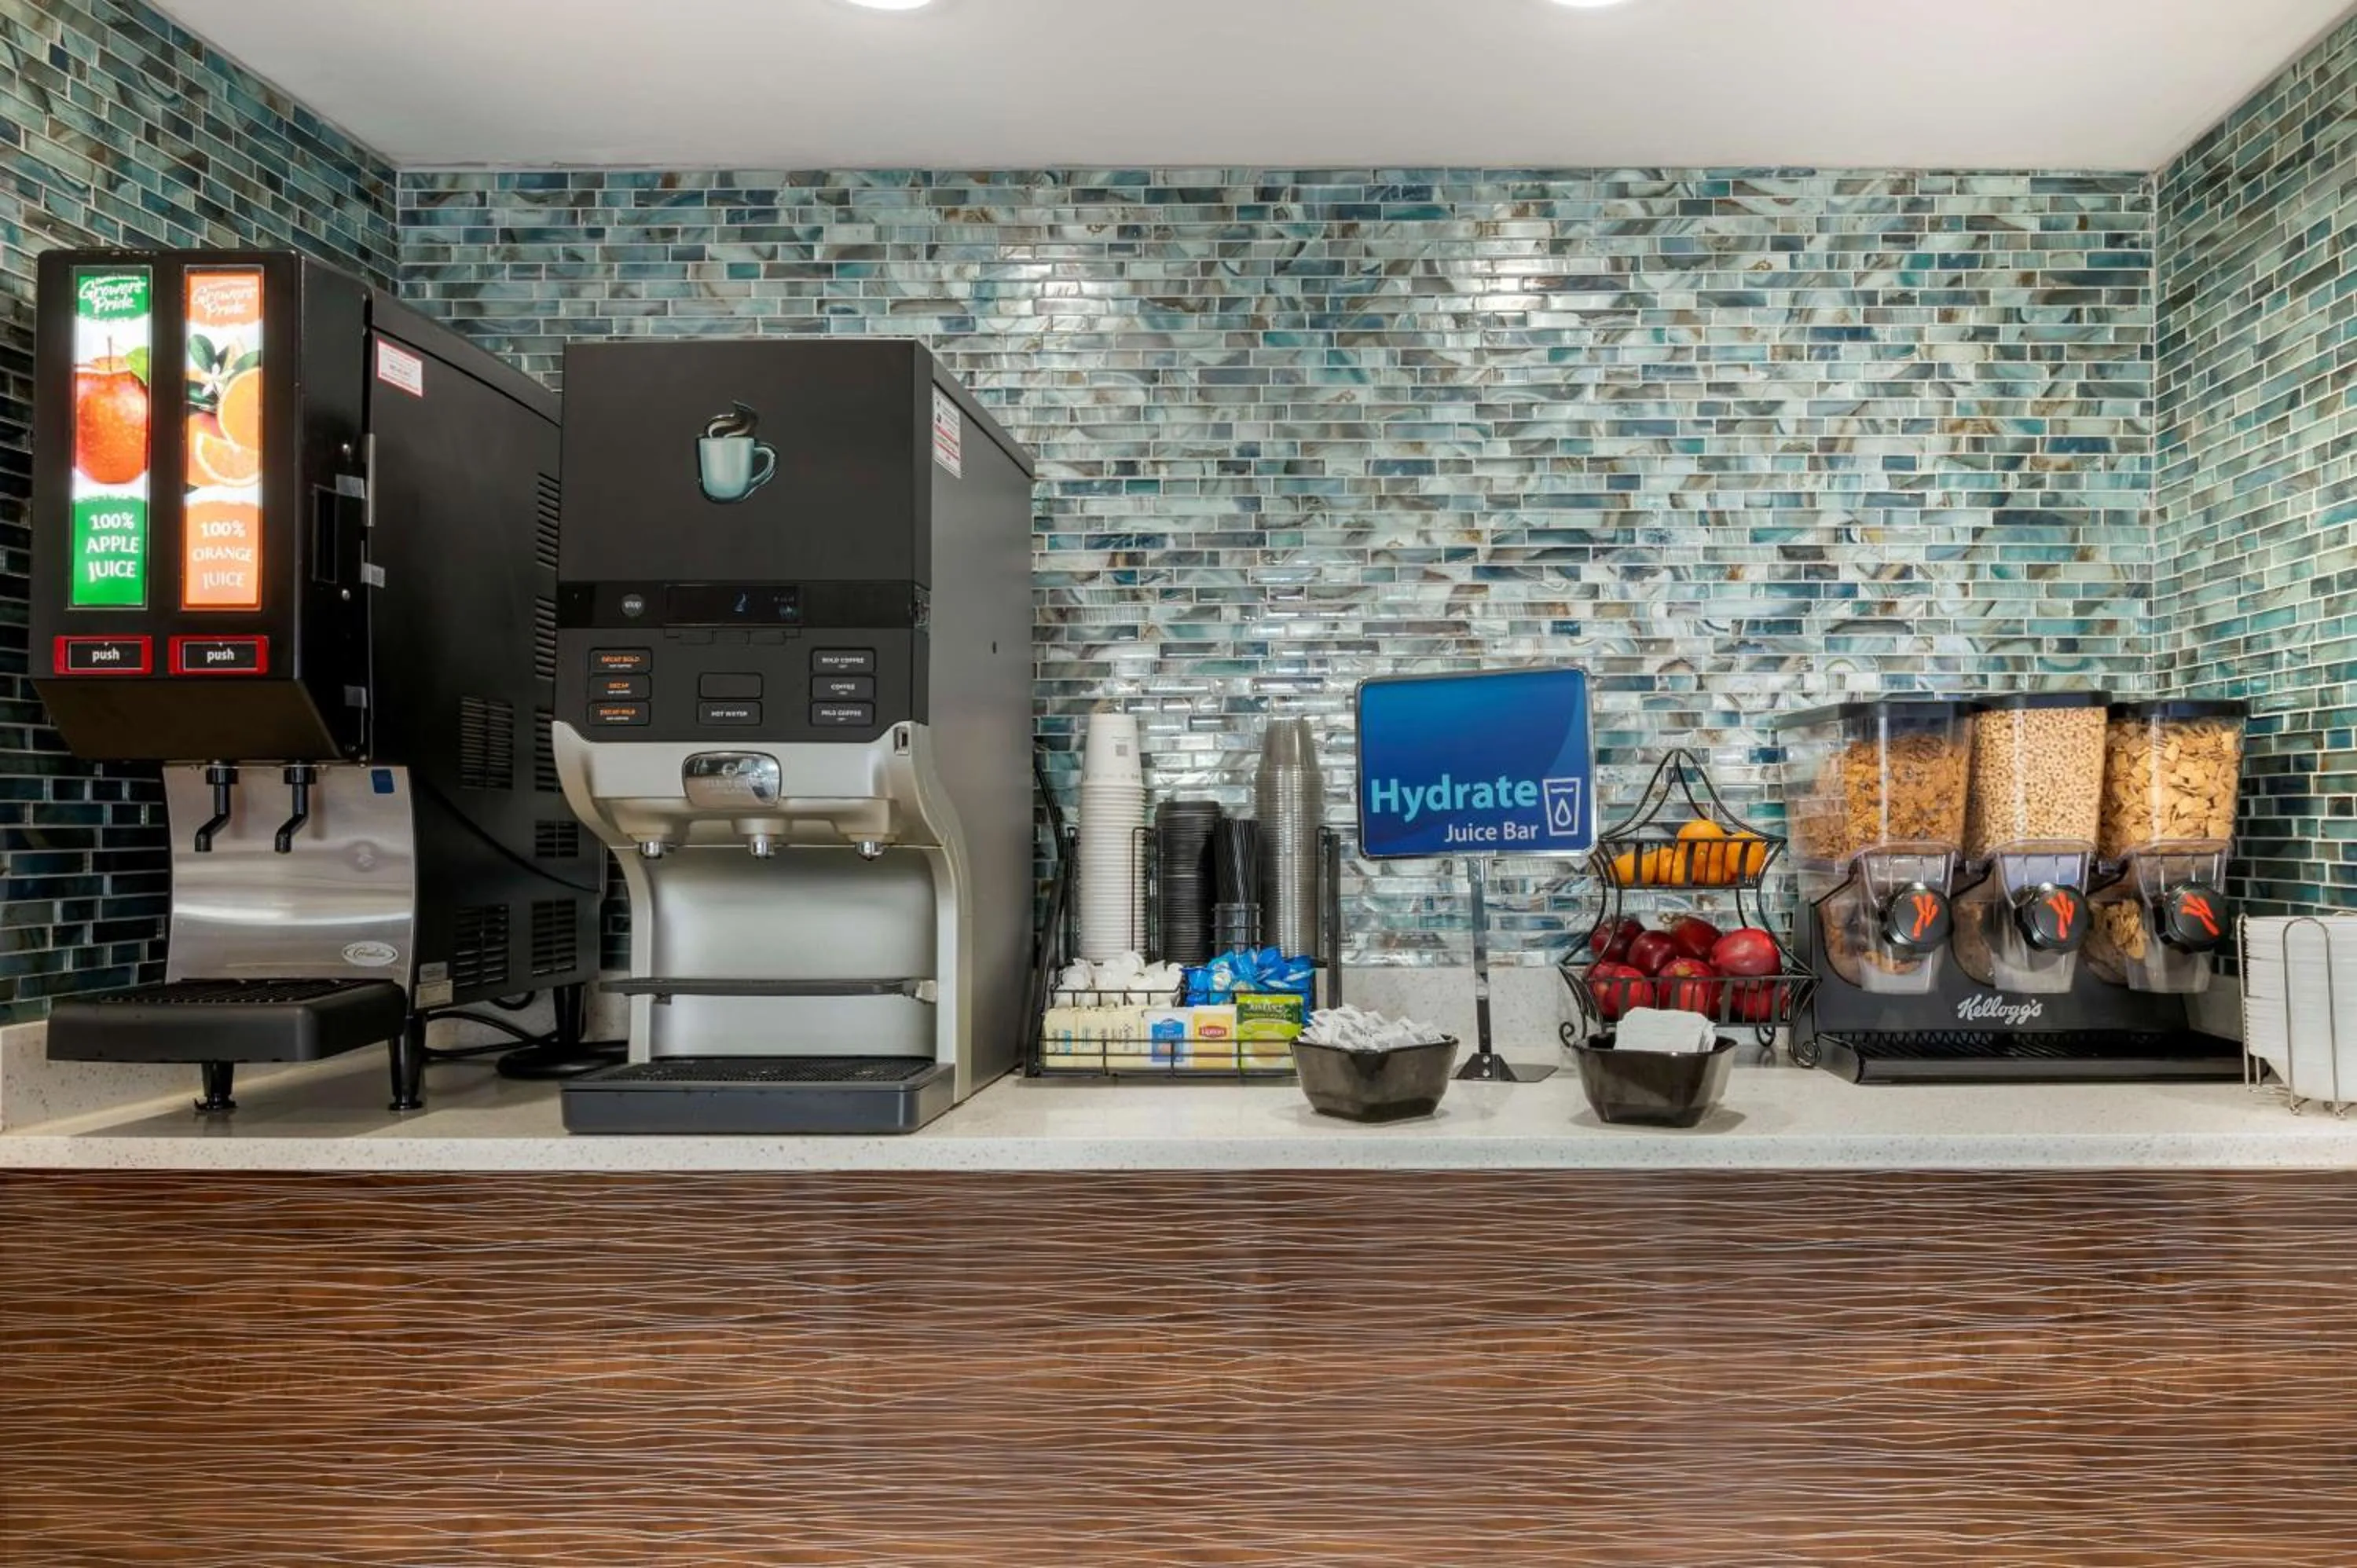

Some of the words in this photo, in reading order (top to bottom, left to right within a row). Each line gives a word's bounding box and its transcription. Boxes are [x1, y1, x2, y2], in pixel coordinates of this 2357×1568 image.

[94, 296, 135, 313] Pride
[90, 512, 134, 529] 100%
[200, 520, 246, 537] 100%
[86, 536, 139, 553] APPLE
[192, 547, 252, 562] ORANGE
[88, 560, 136, 582] JUICE
[202, 572, 245, 590] JUICE
[92, 649, 120, 662] push
[207, 649, 235, 663] push
[1371, 774, 1538, 822] Hydrate
[1444, 823, 1497, 843] Juice
[1503, 820, 1539, 841] Bar
[1957, 994, 2043, 1024] Kellogg's
